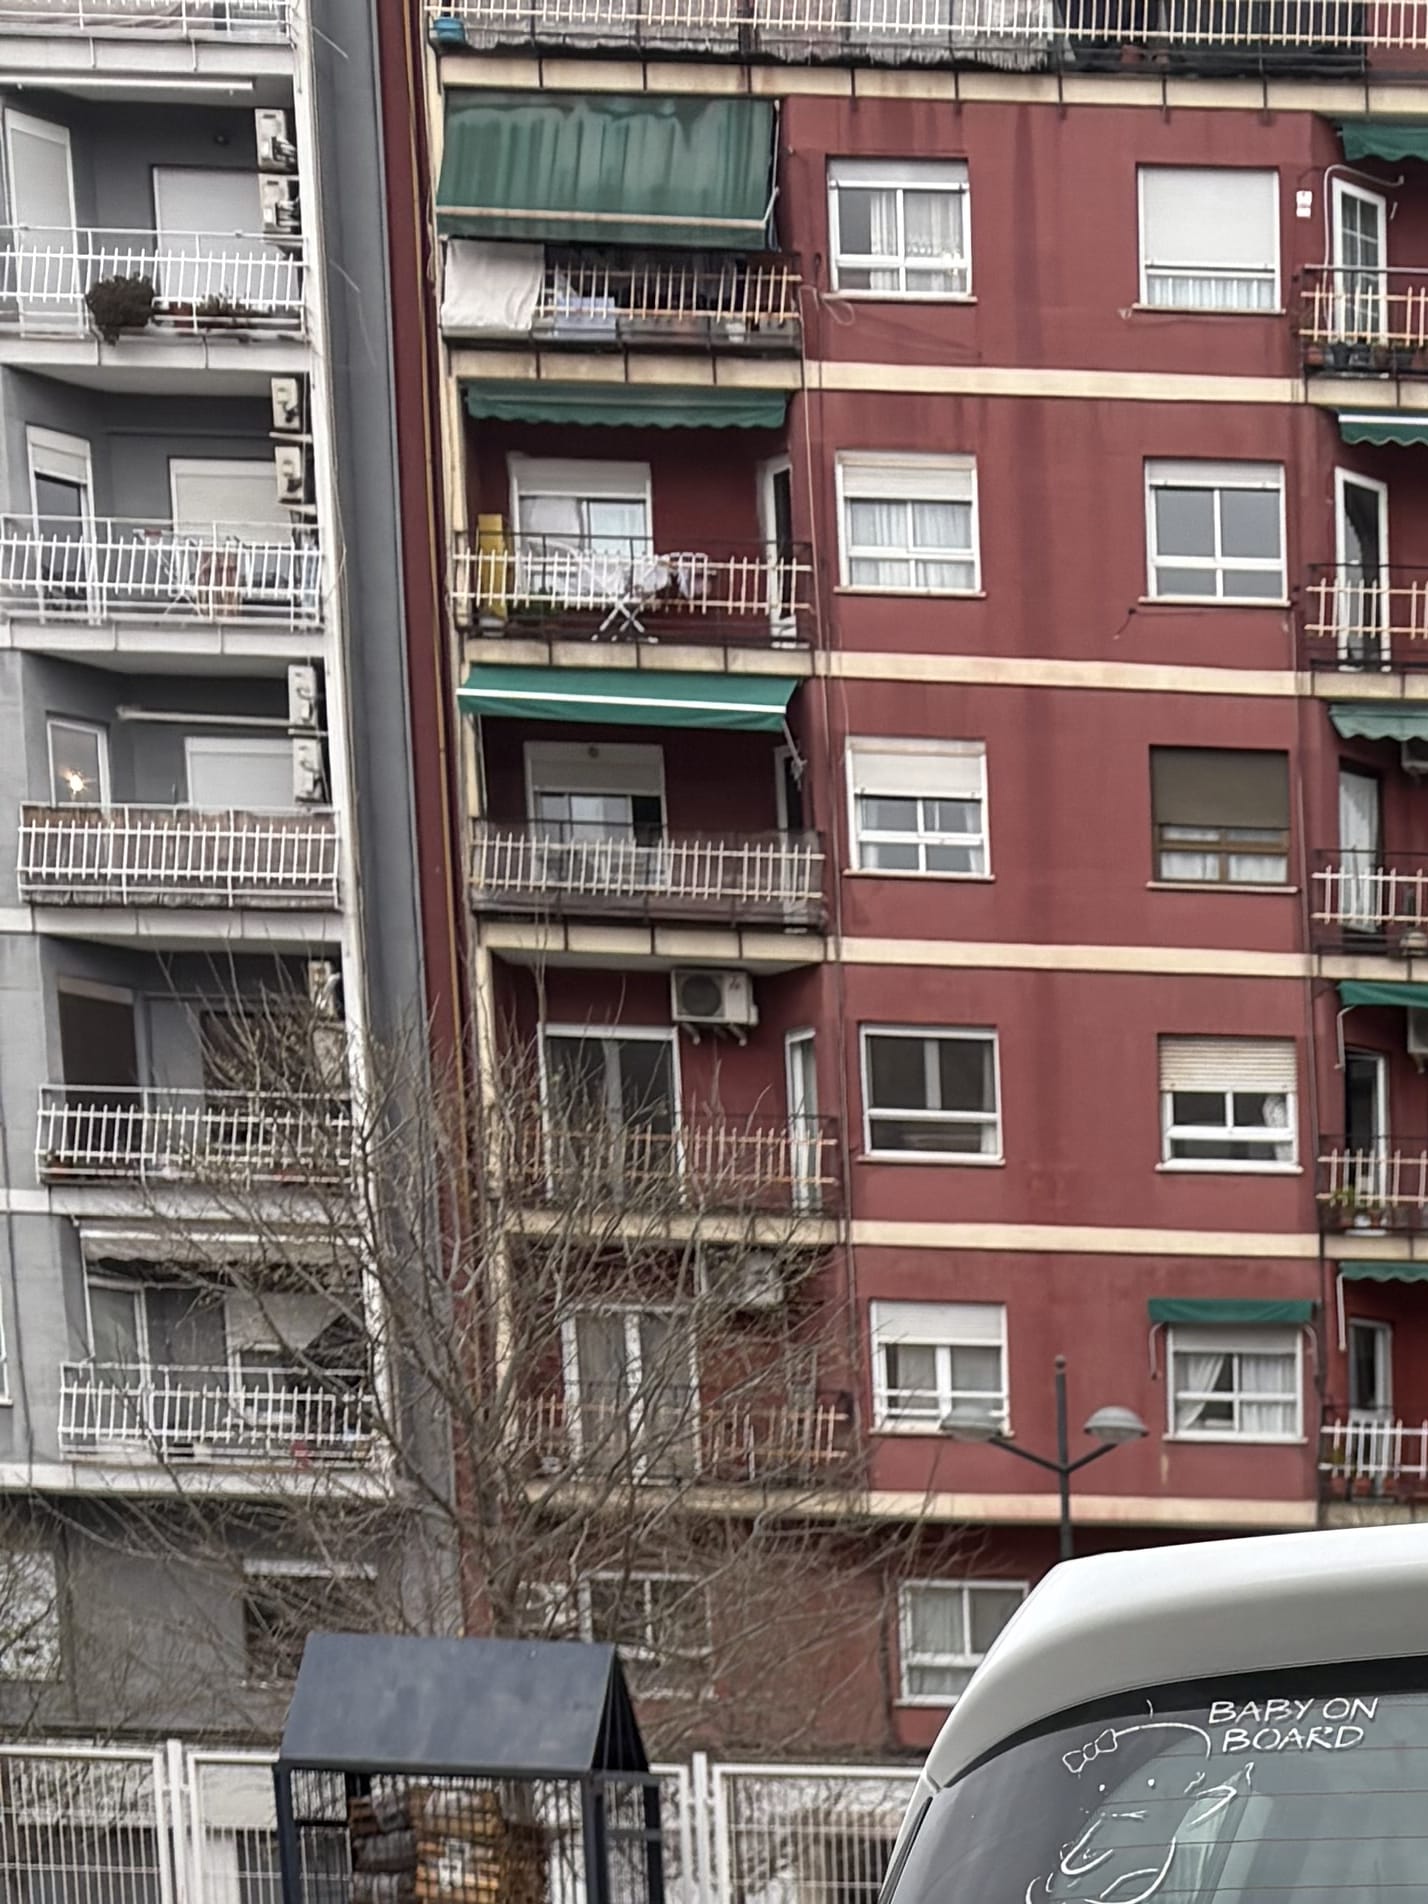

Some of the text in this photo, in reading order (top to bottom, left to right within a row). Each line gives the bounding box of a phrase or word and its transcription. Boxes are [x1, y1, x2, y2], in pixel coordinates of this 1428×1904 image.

[1208, 1697, 1379, 1724] BABY ON
[1222, 1725, 1365, 1753] BOARD
